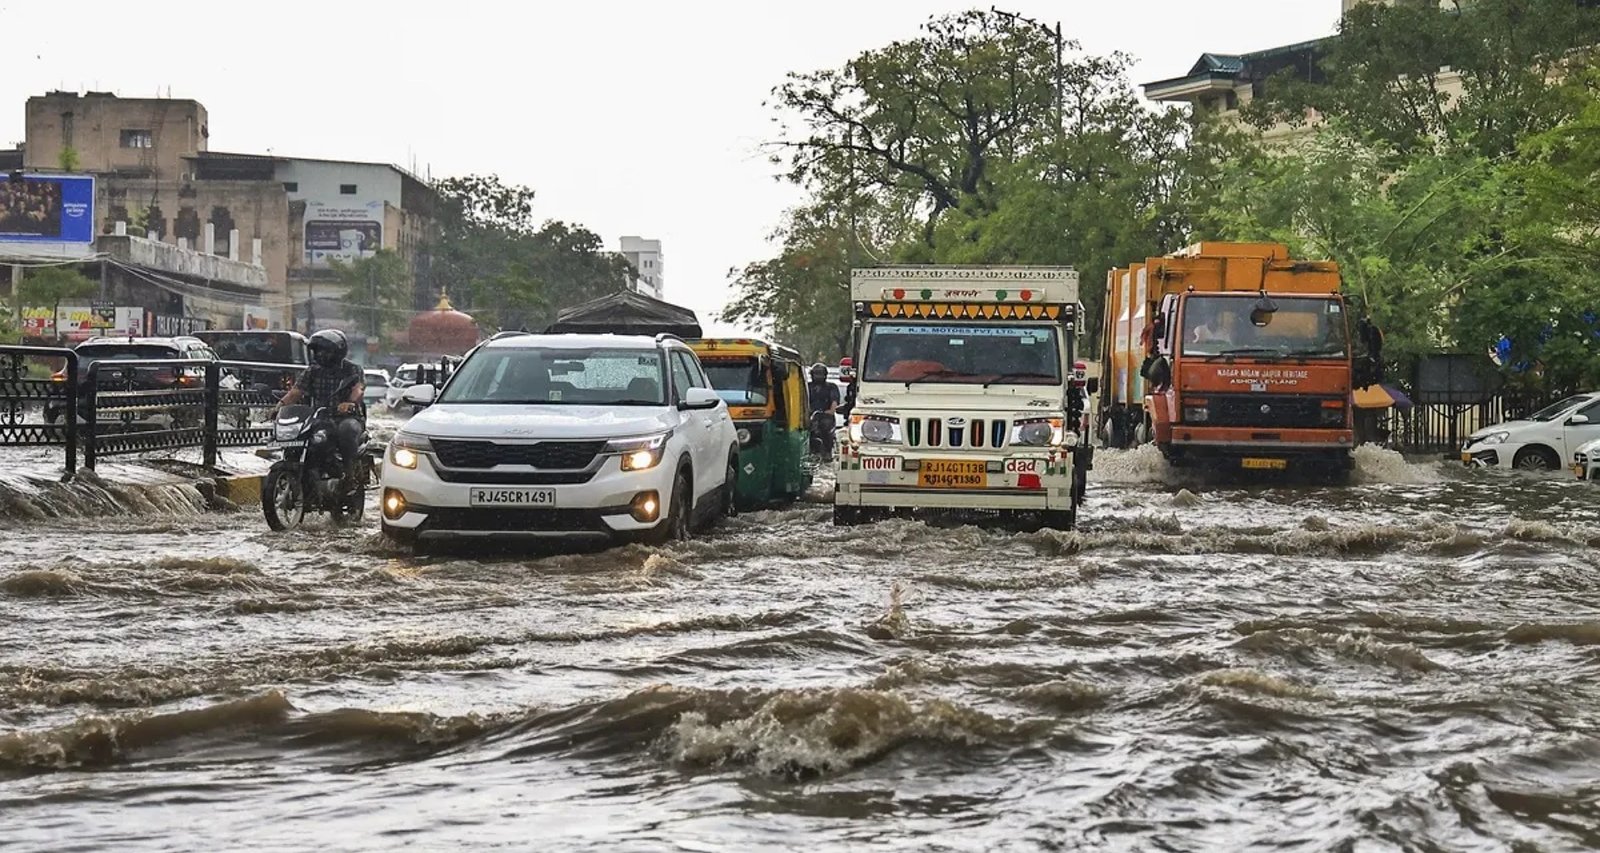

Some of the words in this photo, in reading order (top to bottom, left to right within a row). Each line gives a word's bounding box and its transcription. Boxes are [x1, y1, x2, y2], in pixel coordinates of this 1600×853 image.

[862, 456, 896, 470] mom
[926, 462, 985, 473] RJ14GT138
[1006, 459, 1036, 472] dad
[478, 490, 553, 503] RJ45CR1491
